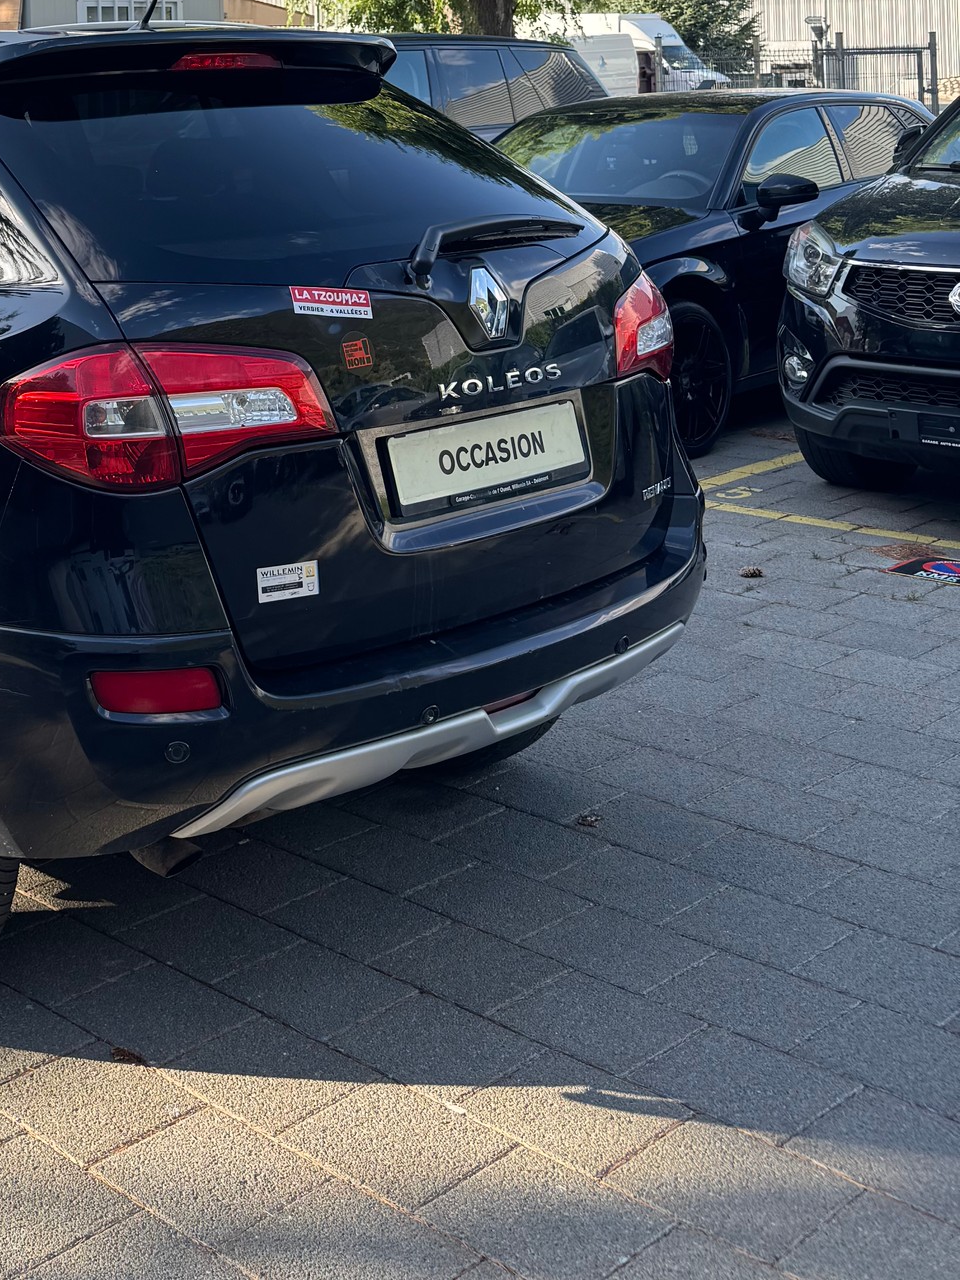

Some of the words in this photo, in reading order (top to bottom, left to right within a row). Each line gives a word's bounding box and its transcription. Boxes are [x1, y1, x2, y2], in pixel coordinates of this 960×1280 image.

[294, 289, 311, 300] LA
[312, 290, 367, 305] TZOUMAZ
[438, 430, 546, 476] OCCASION
[260, 565, 303, 578] WILLEMIN
